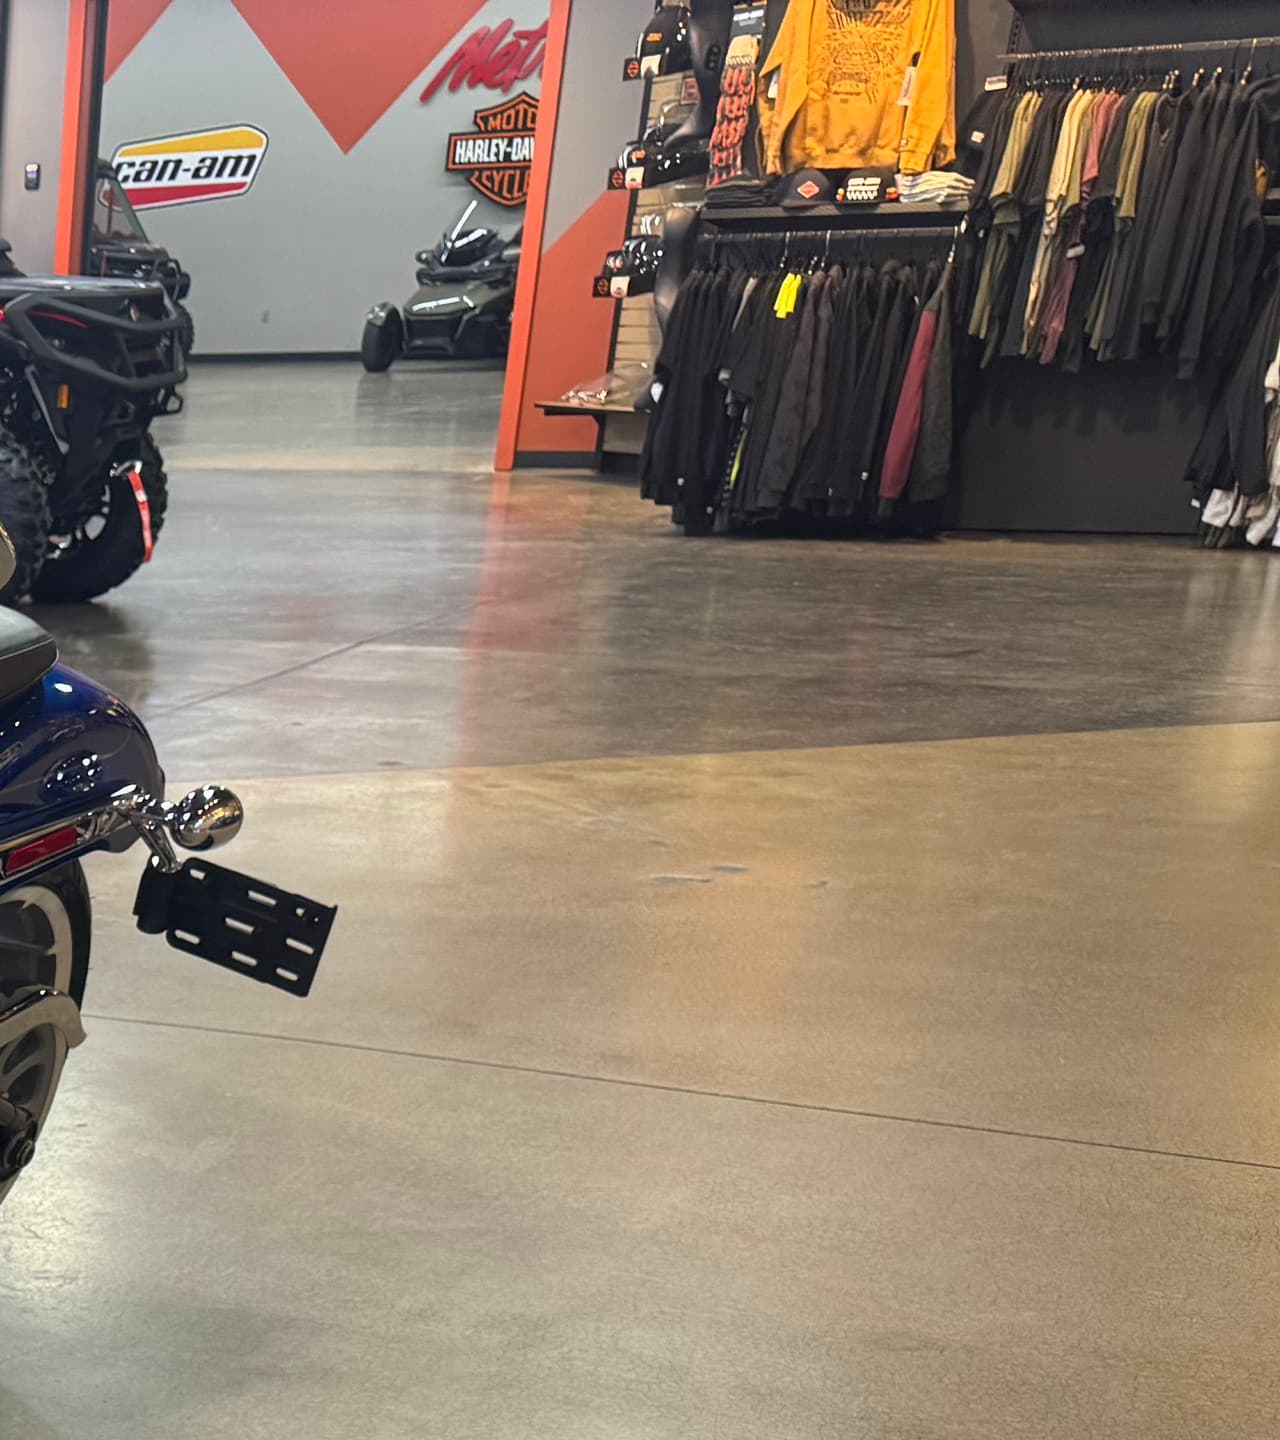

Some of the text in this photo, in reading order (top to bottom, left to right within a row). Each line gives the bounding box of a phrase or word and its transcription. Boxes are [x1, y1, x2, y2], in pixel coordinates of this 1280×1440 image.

[419, 18, 548, 104] Met
[488, 104, 538, 130] MOTO
[115, 153, 257, 184] can-am
[481, 171, 531, 199] CYCL
